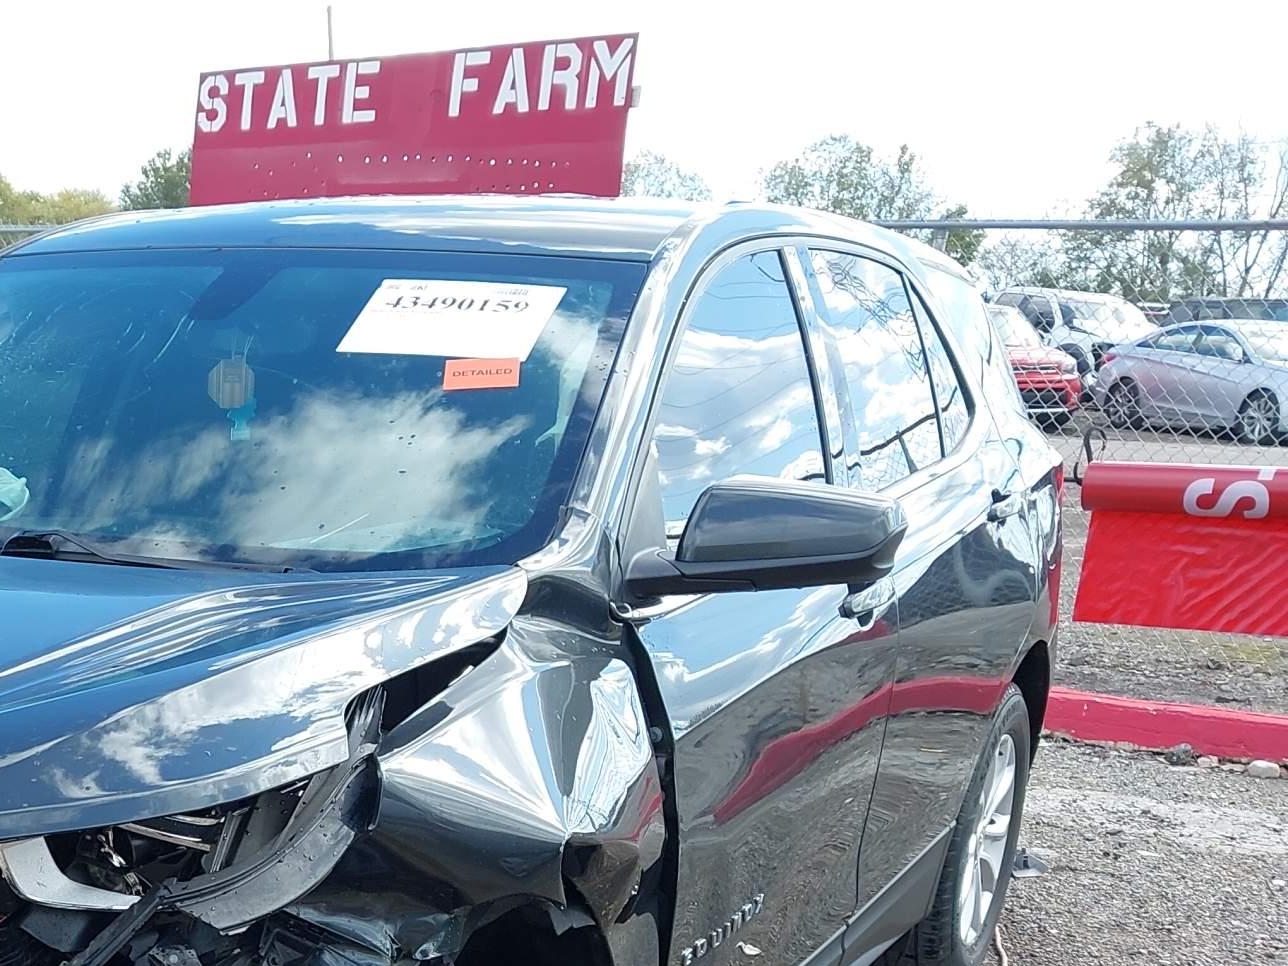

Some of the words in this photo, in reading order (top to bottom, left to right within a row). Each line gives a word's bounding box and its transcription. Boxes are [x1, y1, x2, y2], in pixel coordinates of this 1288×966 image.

[197, 60, 381, 132] STATE
[447, 38, 634, 118] FARM
[386, 295, 530, 313] 43490159
[452, 367, 513, 378] DETAILED
[680, 893, 765, 966] EQUINOX
